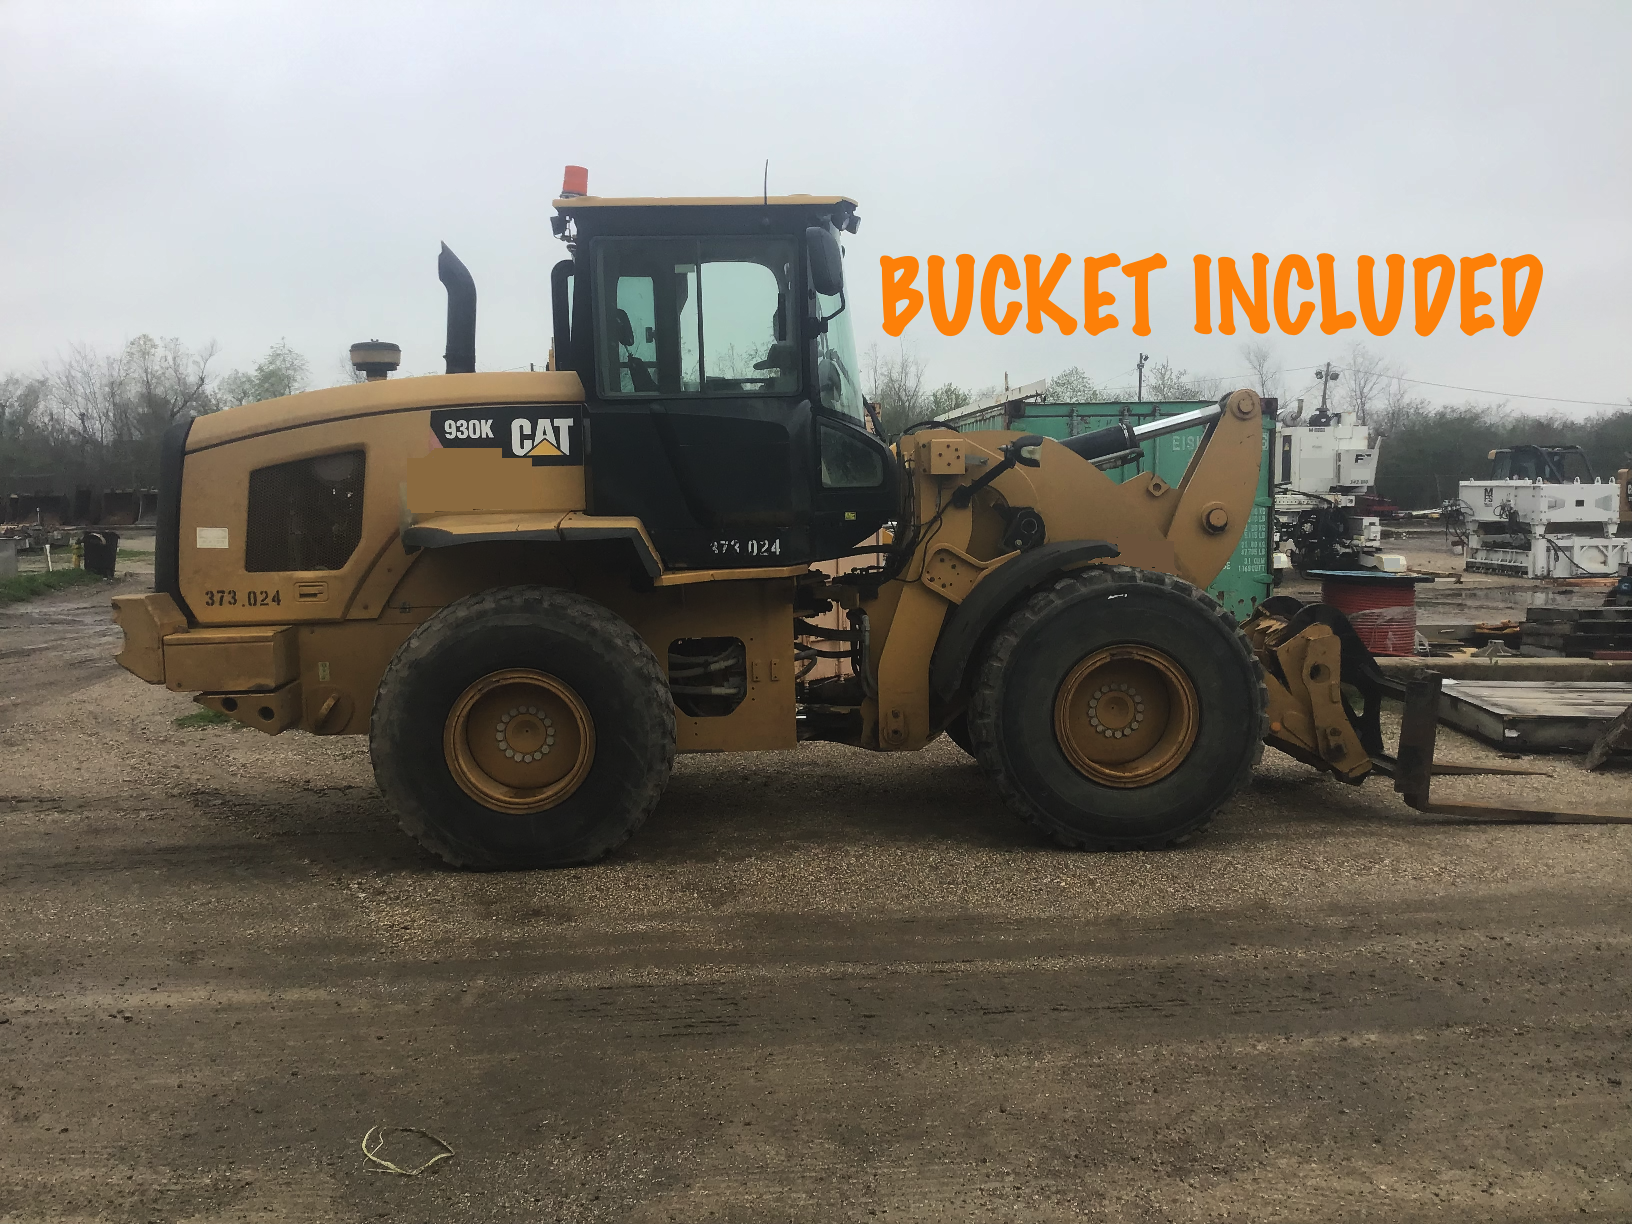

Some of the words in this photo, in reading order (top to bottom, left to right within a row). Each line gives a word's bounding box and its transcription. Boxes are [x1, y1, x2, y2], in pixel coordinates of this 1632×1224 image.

[444, 419, 495, 439] 930K
[511, 417, 574, 457] CAT
[205, 589, 281, 607] 373.024
